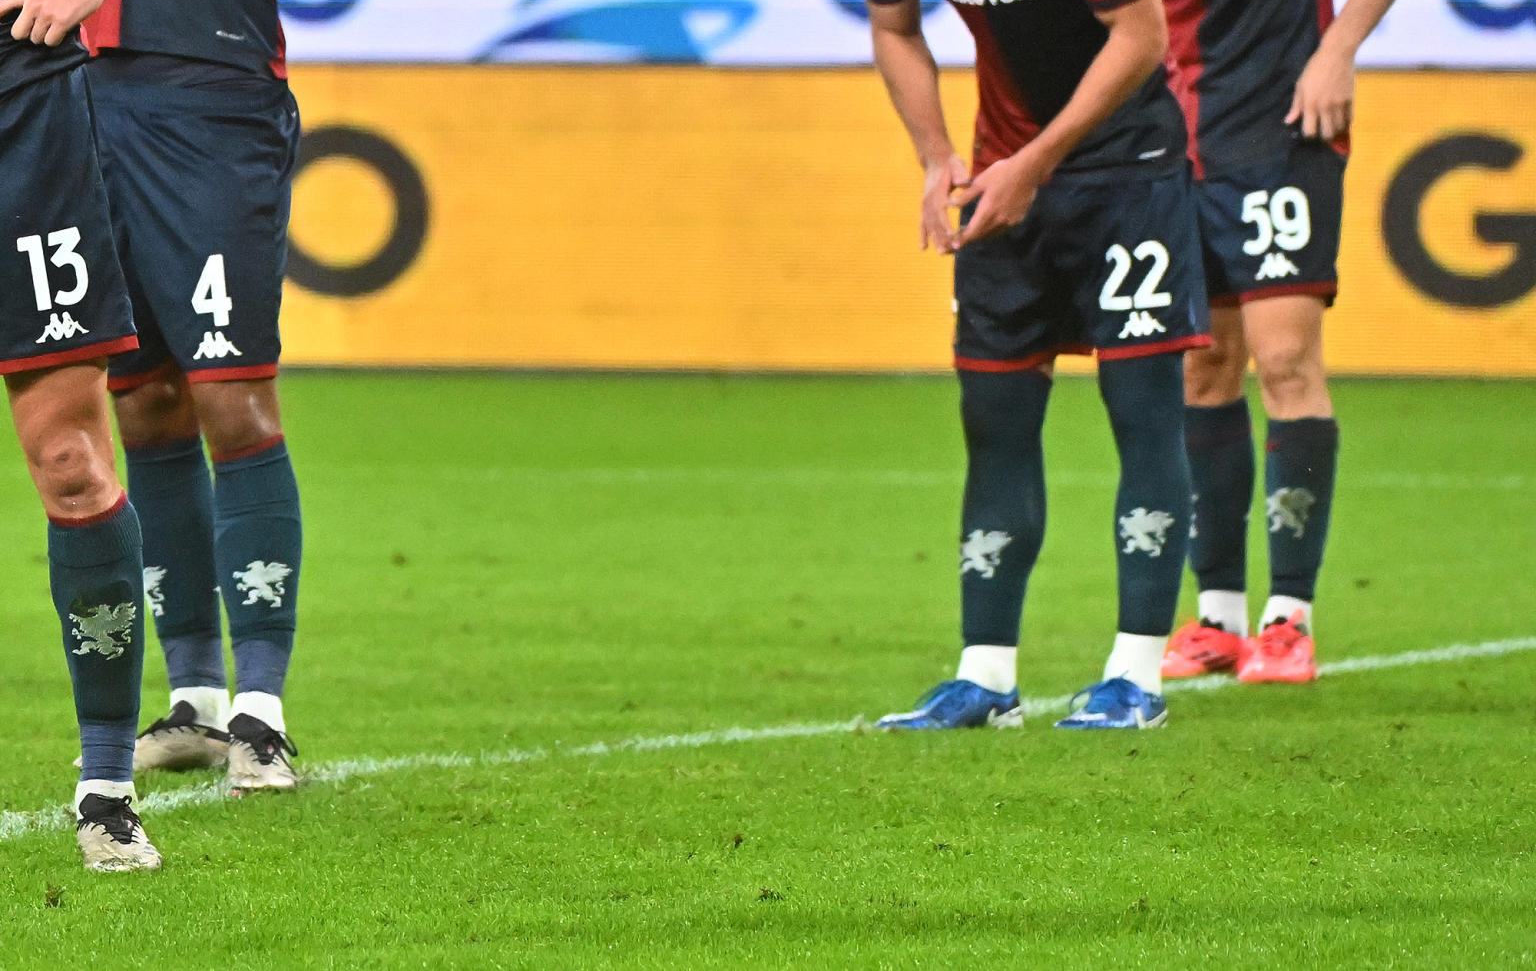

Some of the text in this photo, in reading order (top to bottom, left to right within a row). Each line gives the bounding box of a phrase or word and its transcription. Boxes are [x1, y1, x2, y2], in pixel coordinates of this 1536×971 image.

[1241, 186, 1312, 256] 59
[16, 226, 90, 311] 13
[191, 254, 233, 327] 4
[1099, 240, 1172, 311] 22
